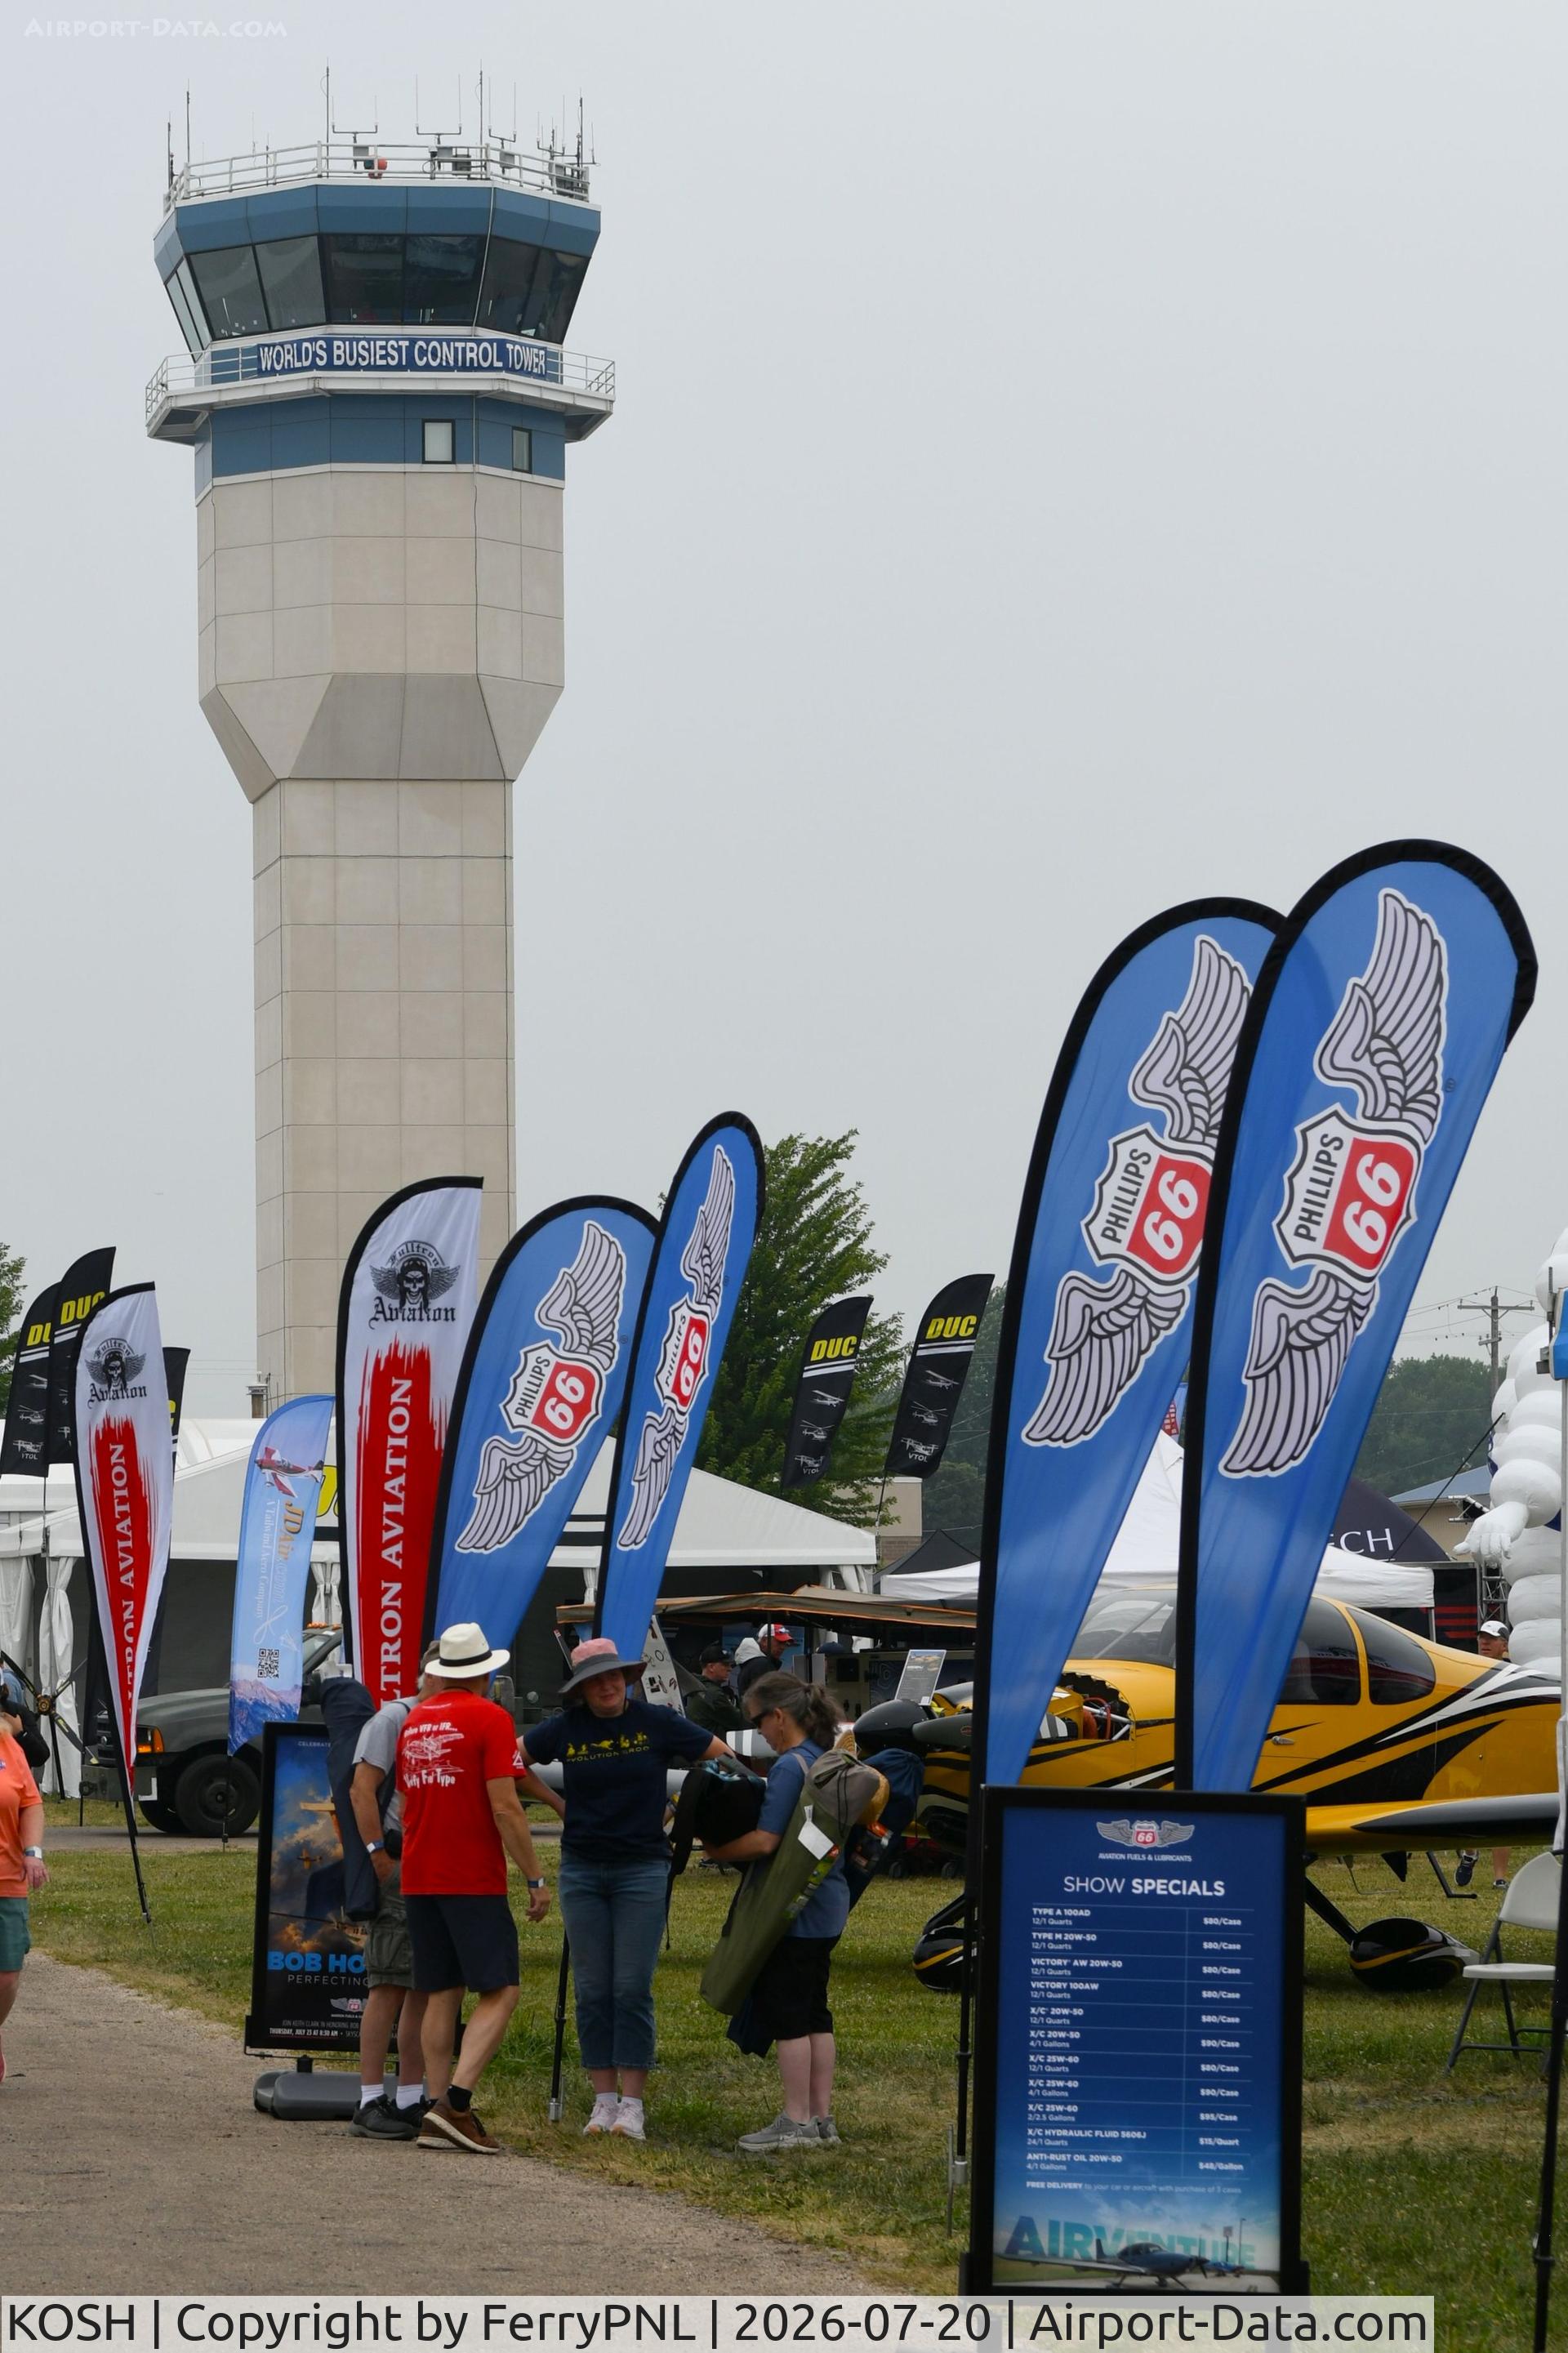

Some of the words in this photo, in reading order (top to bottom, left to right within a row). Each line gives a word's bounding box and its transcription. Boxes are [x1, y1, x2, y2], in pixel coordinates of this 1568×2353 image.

[259, 340, 327, 372] WORLD'S
[332, 340, 409, 367] BUSIEST
[413, 340, 503, 368] CONTROL
[506, 344, 546, 375] TOWER
[1101, 1148, 1152, 1244] PHILLIPS
[1293, 1133, 1344, 1242] PHILLIPS
[1343, 1153, 1401, 1254] 66
[1143, 1170, 1198, 1261] 66
[368, 1295, 457, 1330] Aviation
[925, 1315, 978, 1339] DUC
[26, 1321, 51, 1347] DU
[810, 1335, 858, 1362] DUC
[679, 1326, 702, 1397] 66
[87, 1382, 148, 1409] Aviation
[514, 1356, 550, 1419] PHILLIPS
[544, 1370, 586, 1431] 66
[381, 1376, 413, 1569] AVIATION
[908, 1451, 928, 1464] VTOL
[110, 1442, 136, 1594] AVIATION
[261, 1508, 275, 1549] Tailwind
[1330, 1527, 1394, 1554] CH
[254, 1576, 267, 1620] Company
[419, 1723, 432, 1732] VFR
[436, 1767, 456, 1787] Type
[1137, 1832, 1154, 1843] 66
[1098, 1852, 1125, 1861] AVIATION
[1127, 1853, 1146, 1861] FUELS
[1154, 1854, 1192, 1862] LUBRICANTS
[1063, 1876, 1126, 1894] SHOW
[1131, 1878, 1225, 1896] SPECIALS
[267, 1950, 323, 1972] BOB
[328, 1953, 368, 1974] HO
